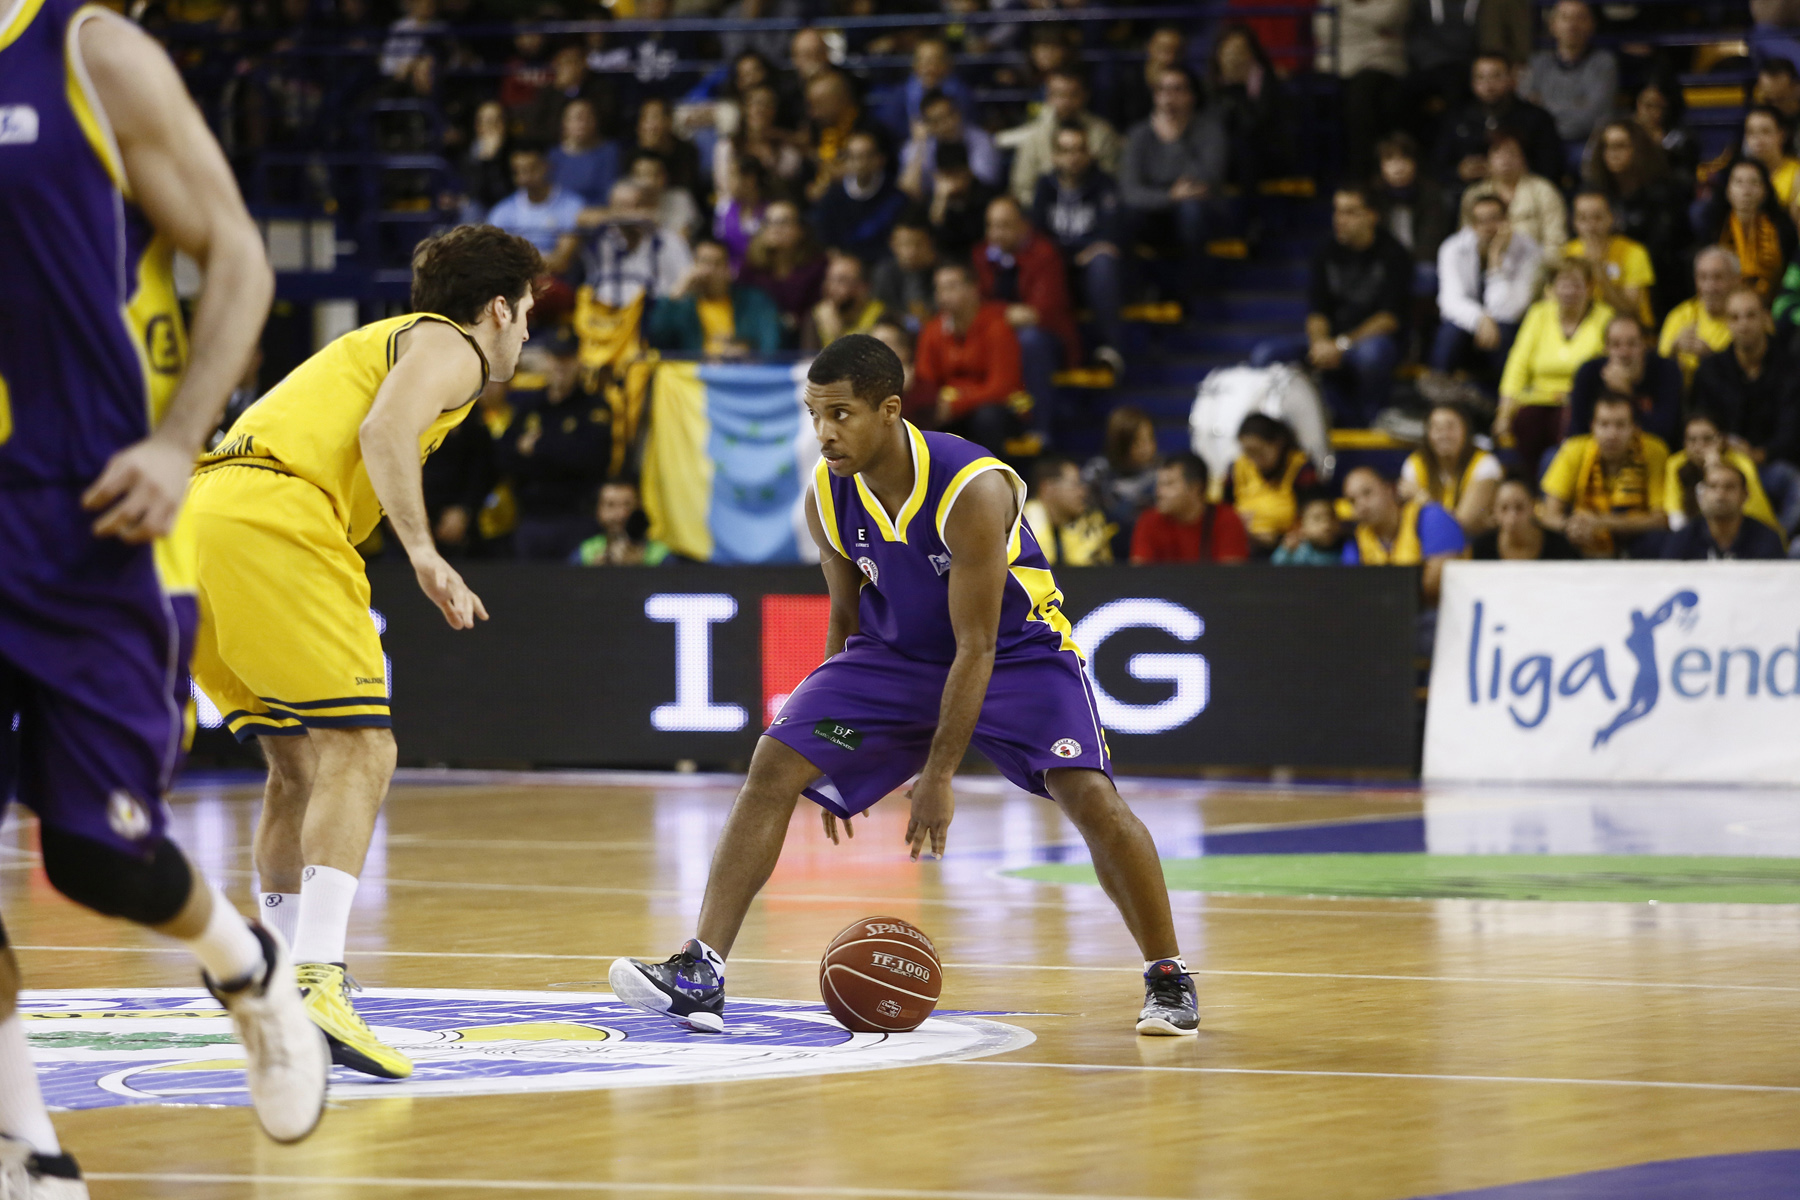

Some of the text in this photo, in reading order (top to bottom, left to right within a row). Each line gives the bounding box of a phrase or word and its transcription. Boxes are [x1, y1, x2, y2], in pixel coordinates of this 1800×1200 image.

[857, 528, 866, 541] E
[645, 593, 1211, 734] I G
[1469, 600, 1617, 728] liga
[872, 953, 930, 981] TF-1000
